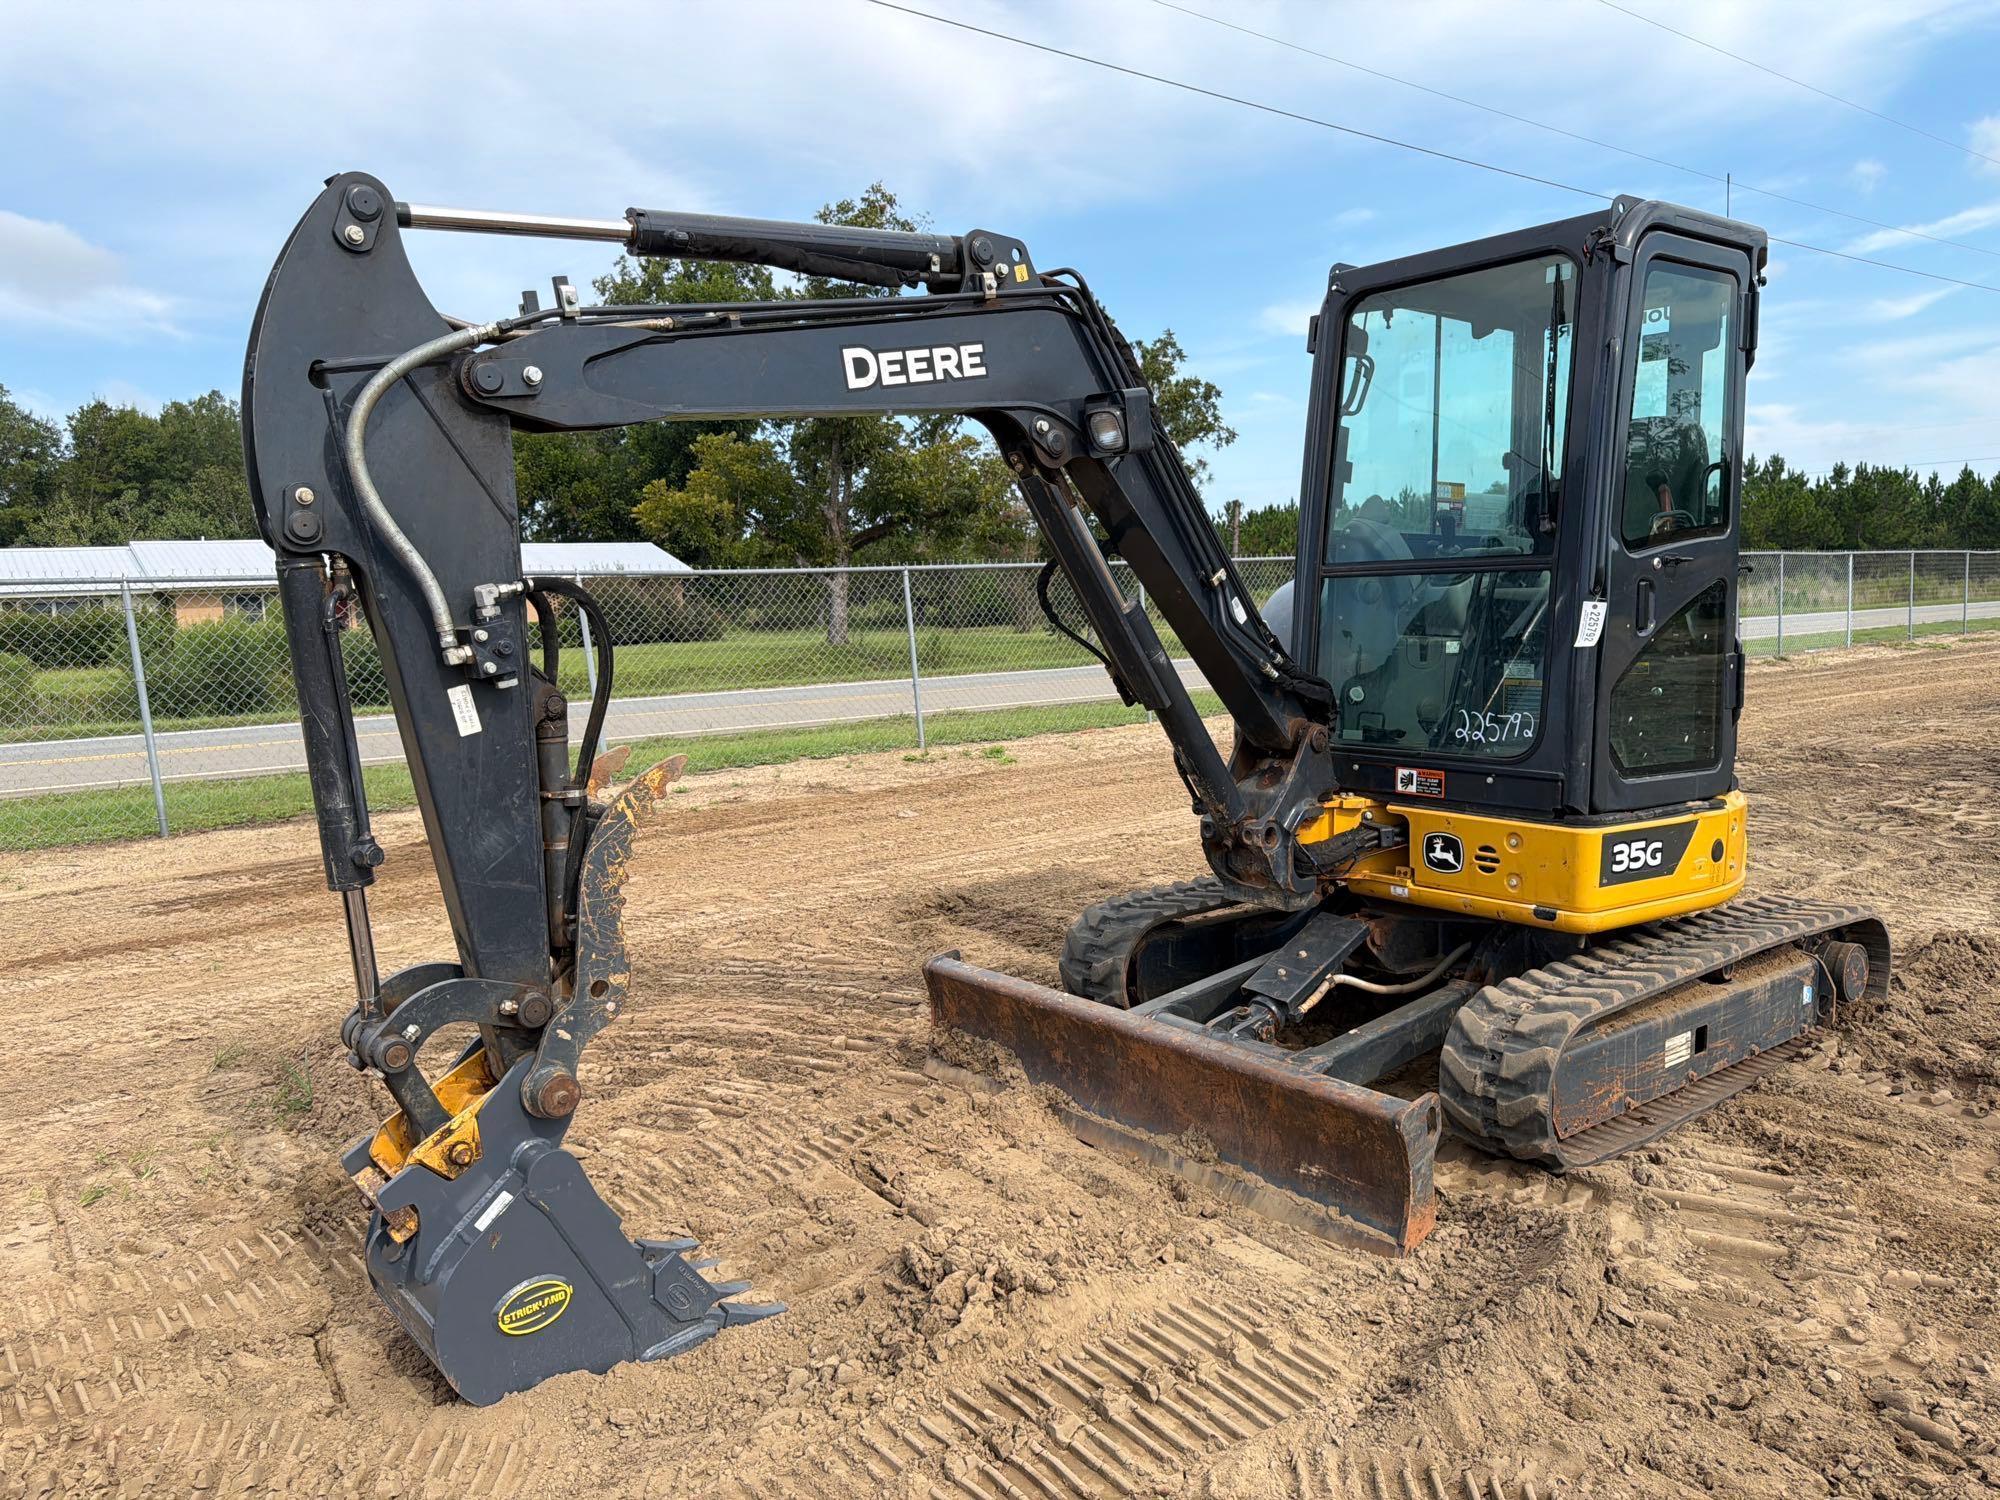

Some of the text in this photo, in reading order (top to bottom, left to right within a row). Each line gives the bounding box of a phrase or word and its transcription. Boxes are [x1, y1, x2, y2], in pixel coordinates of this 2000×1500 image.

[842, 343, 987, 389] DEERE
[1583, 610, 1601, 642] 225792
[1455, 709, 1534, 743] 225792
[1612, 840, 1663, 872] 35G
[503, 1290, 566, 1324] STRICKLAND
